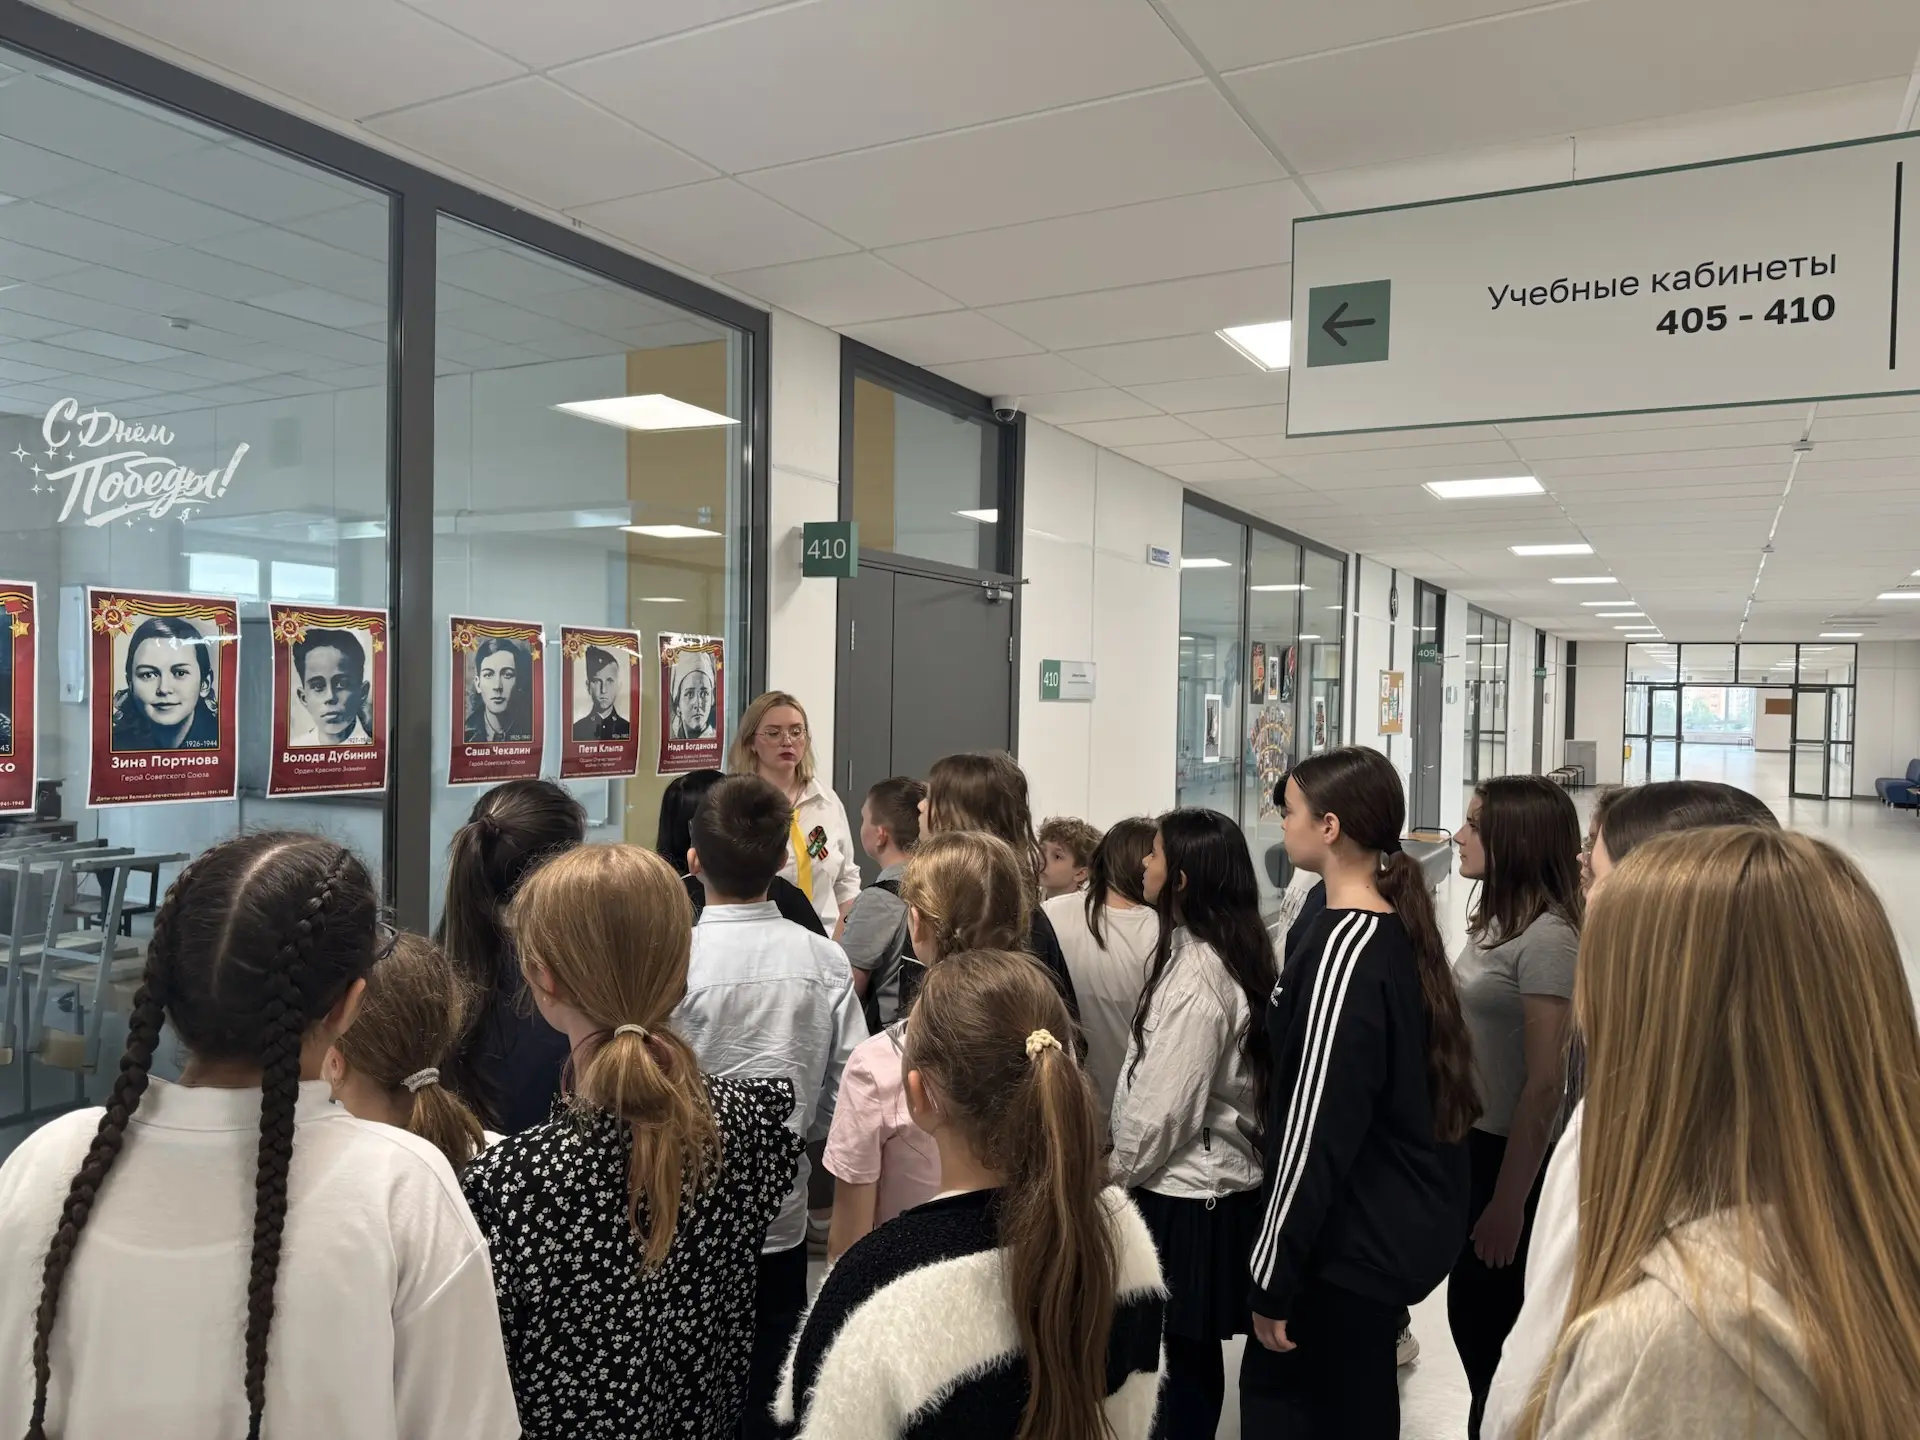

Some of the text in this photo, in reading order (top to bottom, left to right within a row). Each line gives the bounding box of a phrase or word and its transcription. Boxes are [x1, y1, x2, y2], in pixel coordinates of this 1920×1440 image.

[1488, 253, 1837, 311] Учебные кабинеты
[1656, 304, 1728, 336] 405
[1764, 294, 1836, 326] 410
[42, 397, 175, 447] С Днём
[45, 442, 250, 527] Победы!
[807, 539, 847, 560] 410
[1418, 649, 1435, 657] 409
[1043, 671, 1059, 687] 410
[465, 746, 530, 756] Саша Чекалин
[578, 744, 624, 754] Петя Клыпа
[667, 742, 718, 752] Надя Богданова
[111, 756, 219, 769] Зина Портнова
[283, 751, 377, 763] Володя Дубинин
[314, 766, 341, 774] Красного
[121, 771, 209, 782] Герой Советского Союза
